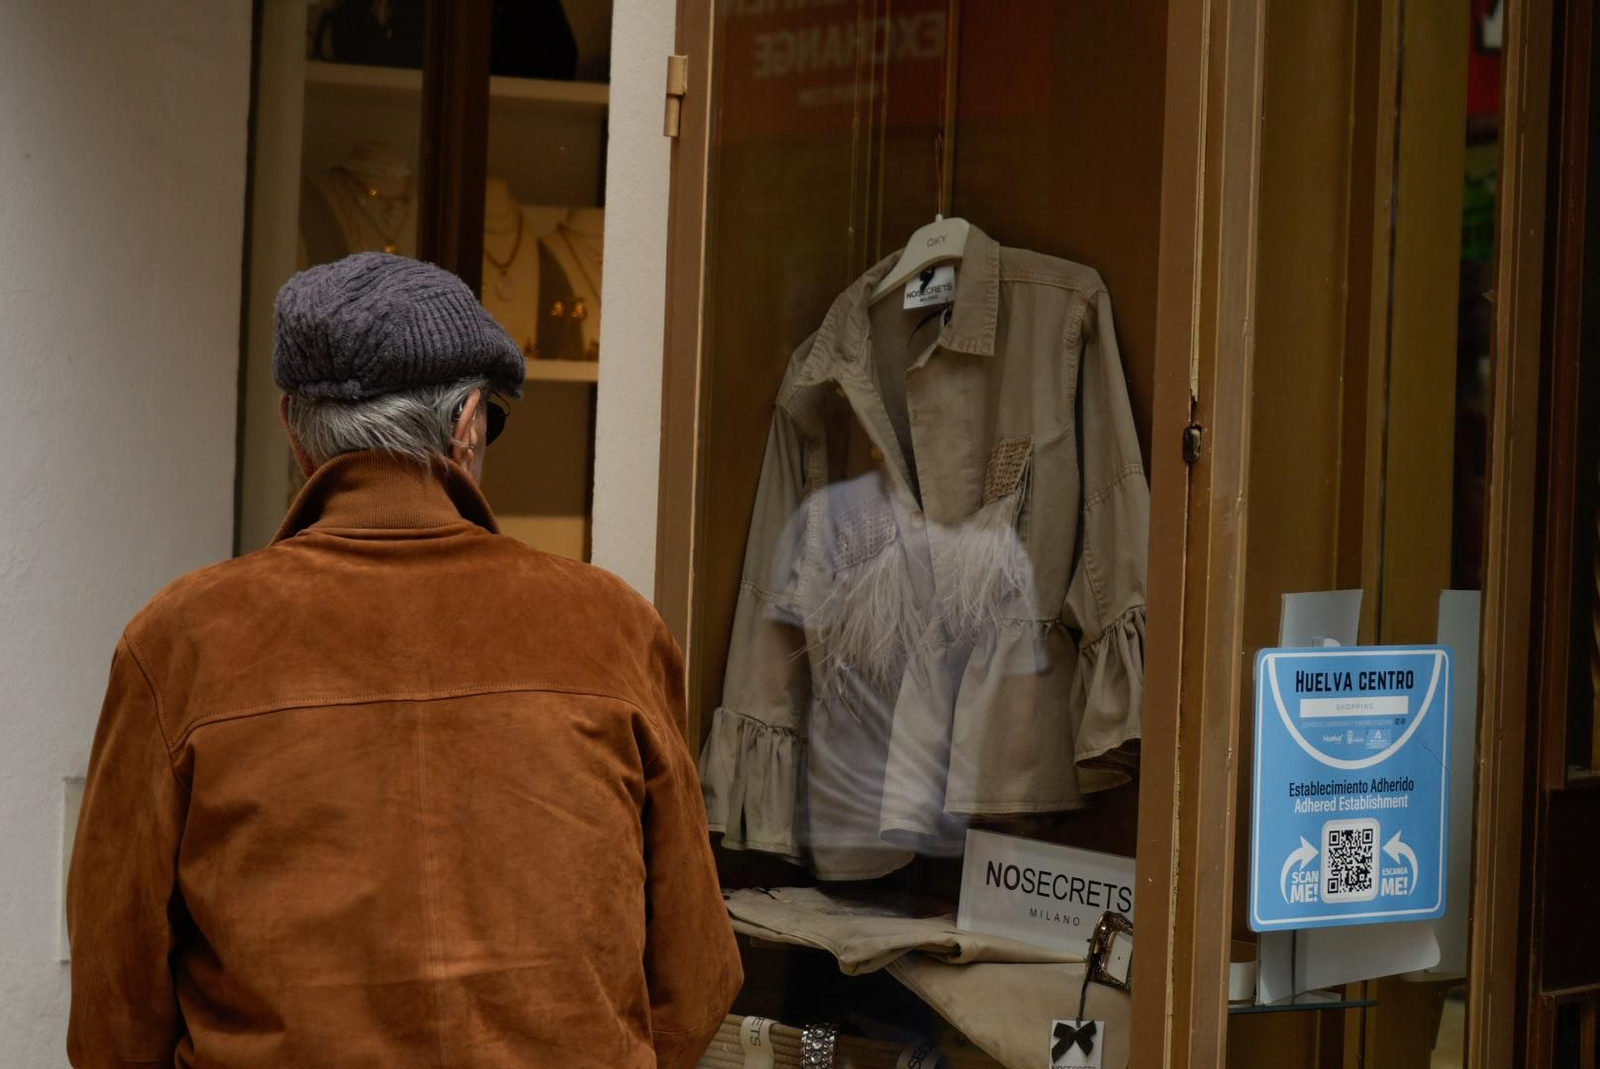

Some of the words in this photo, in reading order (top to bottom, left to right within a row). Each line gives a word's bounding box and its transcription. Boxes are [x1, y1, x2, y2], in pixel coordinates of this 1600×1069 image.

[1295, 670, 1353, 692] HUELVA
[1358, 670, 1414, 691] CENTRO
[1336, 703, 1374, 711] SHOPPING
[1289, 779, 1368, 797] Establecimiento
[1370, 777, 1414, 793] Adherido
[1294, 797, 1337, 813] Adhered
[1338, 795, 1408, 811] Establishment
[1292, 870, 1319, 884] SCAN
[1382, 867, 1408, 875] ESCANEA
[986, 860, 1132, 913] NOSECRETS
[1290, 884, 1318, 904] ME!
[1381, 877, 1408, 896] ME!
[1029, 908, 1081, 927] MILANO
